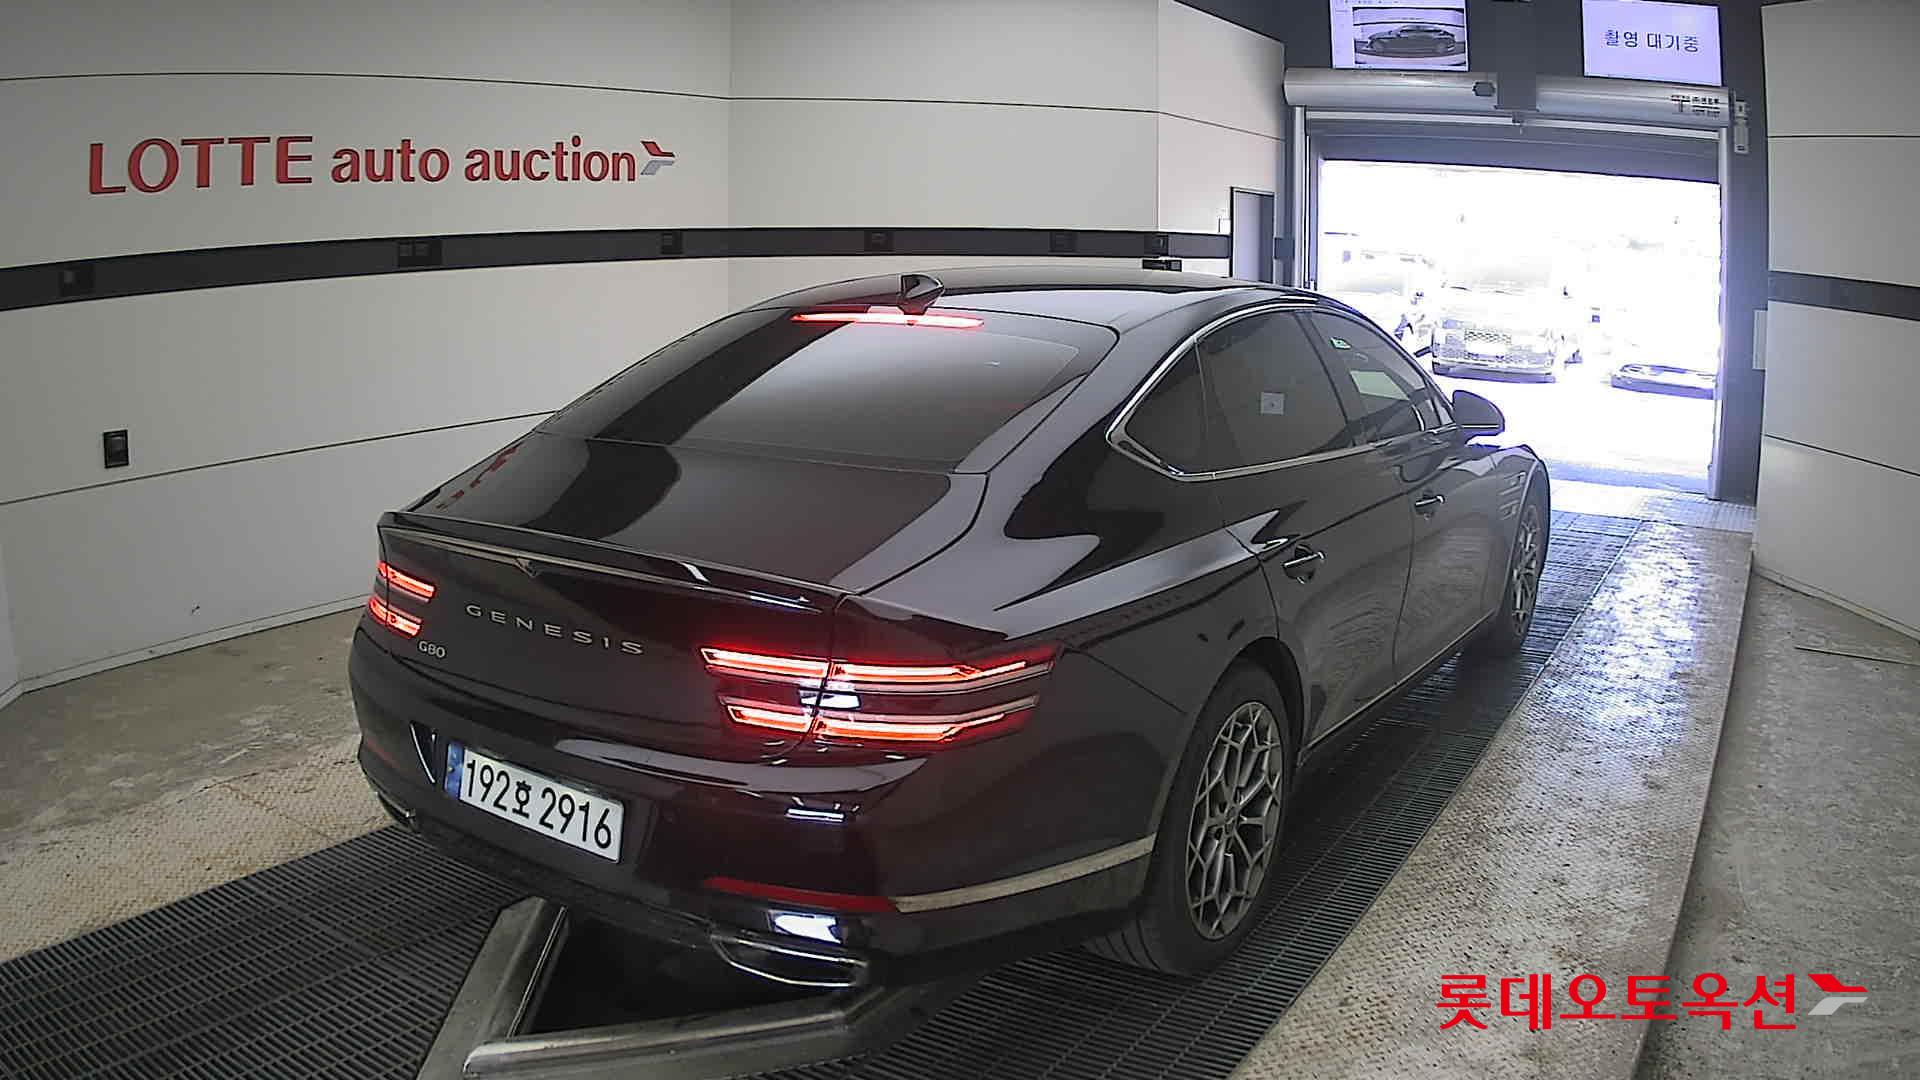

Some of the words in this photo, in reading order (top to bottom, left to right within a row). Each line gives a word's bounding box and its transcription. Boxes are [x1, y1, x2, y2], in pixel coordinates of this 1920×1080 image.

[1647, 33, 1698, 53] 대기중
[89, 136, 313, 194] LOTTE
[330, 138, 450, 183] auto
[464, 135, 636, 182] auction
[466, 604, 643, 655] GENESIS
[418, 639, 446, 659] G80
